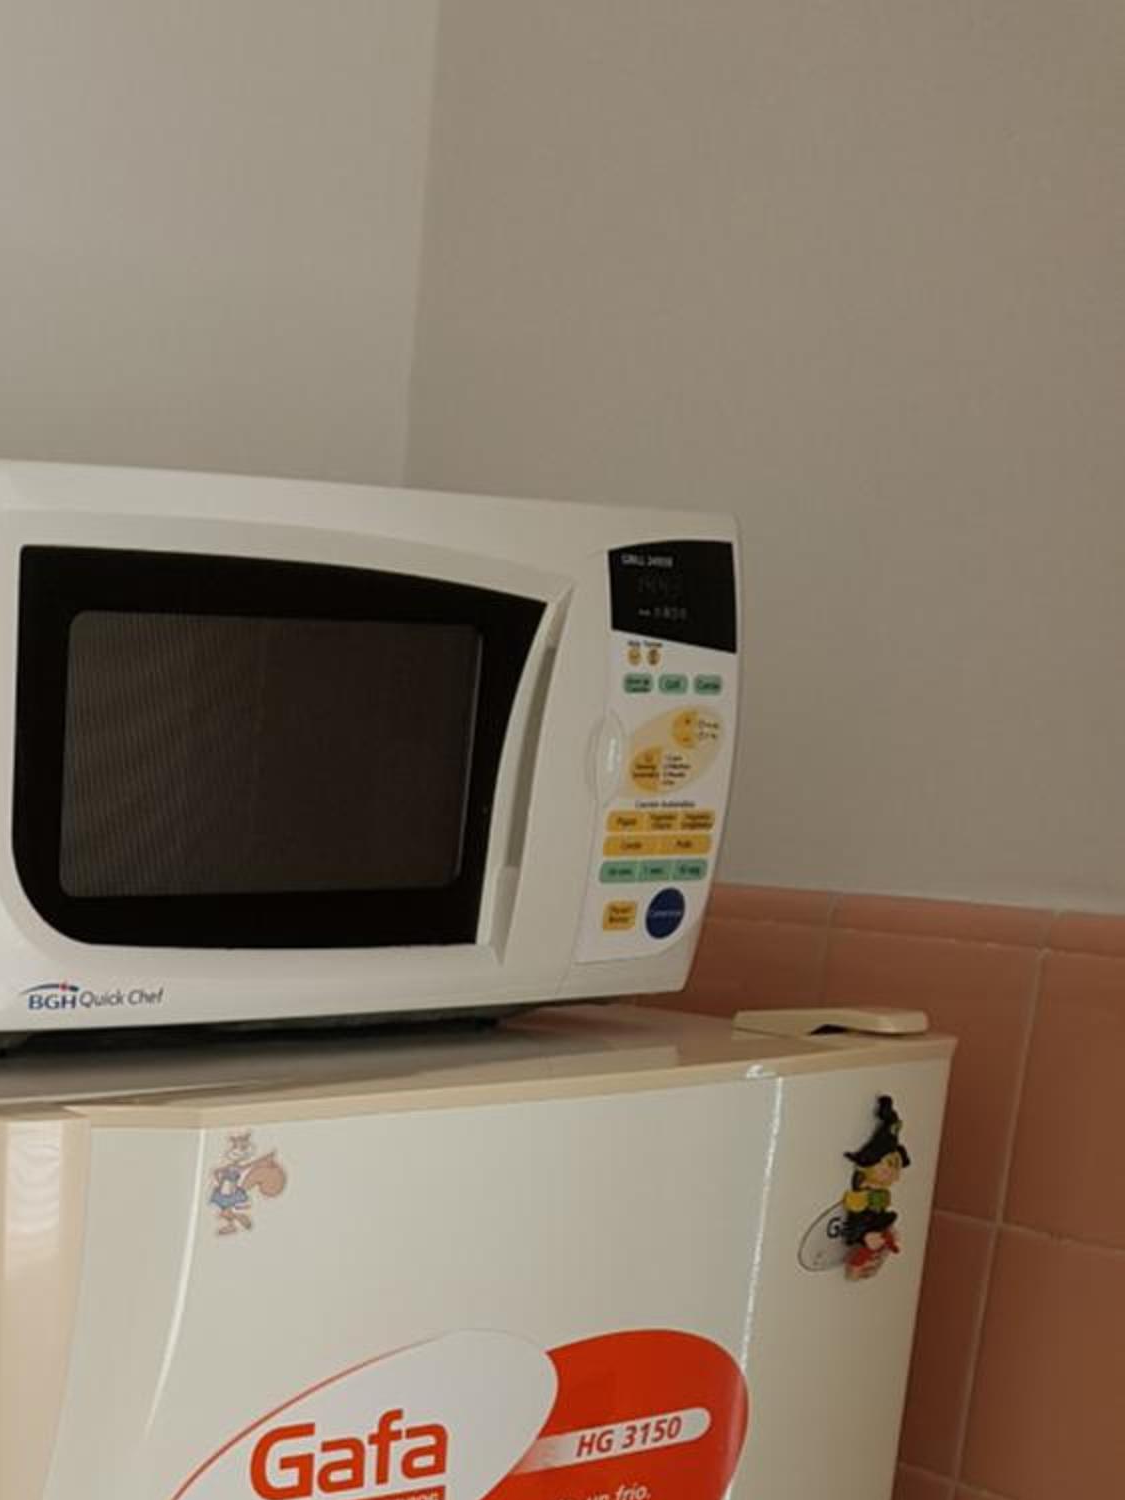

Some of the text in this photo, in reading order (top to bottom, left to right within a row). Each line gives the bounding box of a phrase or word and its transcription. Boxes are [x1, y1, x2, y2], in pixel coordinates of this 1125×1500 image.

[28, 987, 164, 1010] BGH Quick Chef
[576, 1415, 683, 1457] HG 3150
